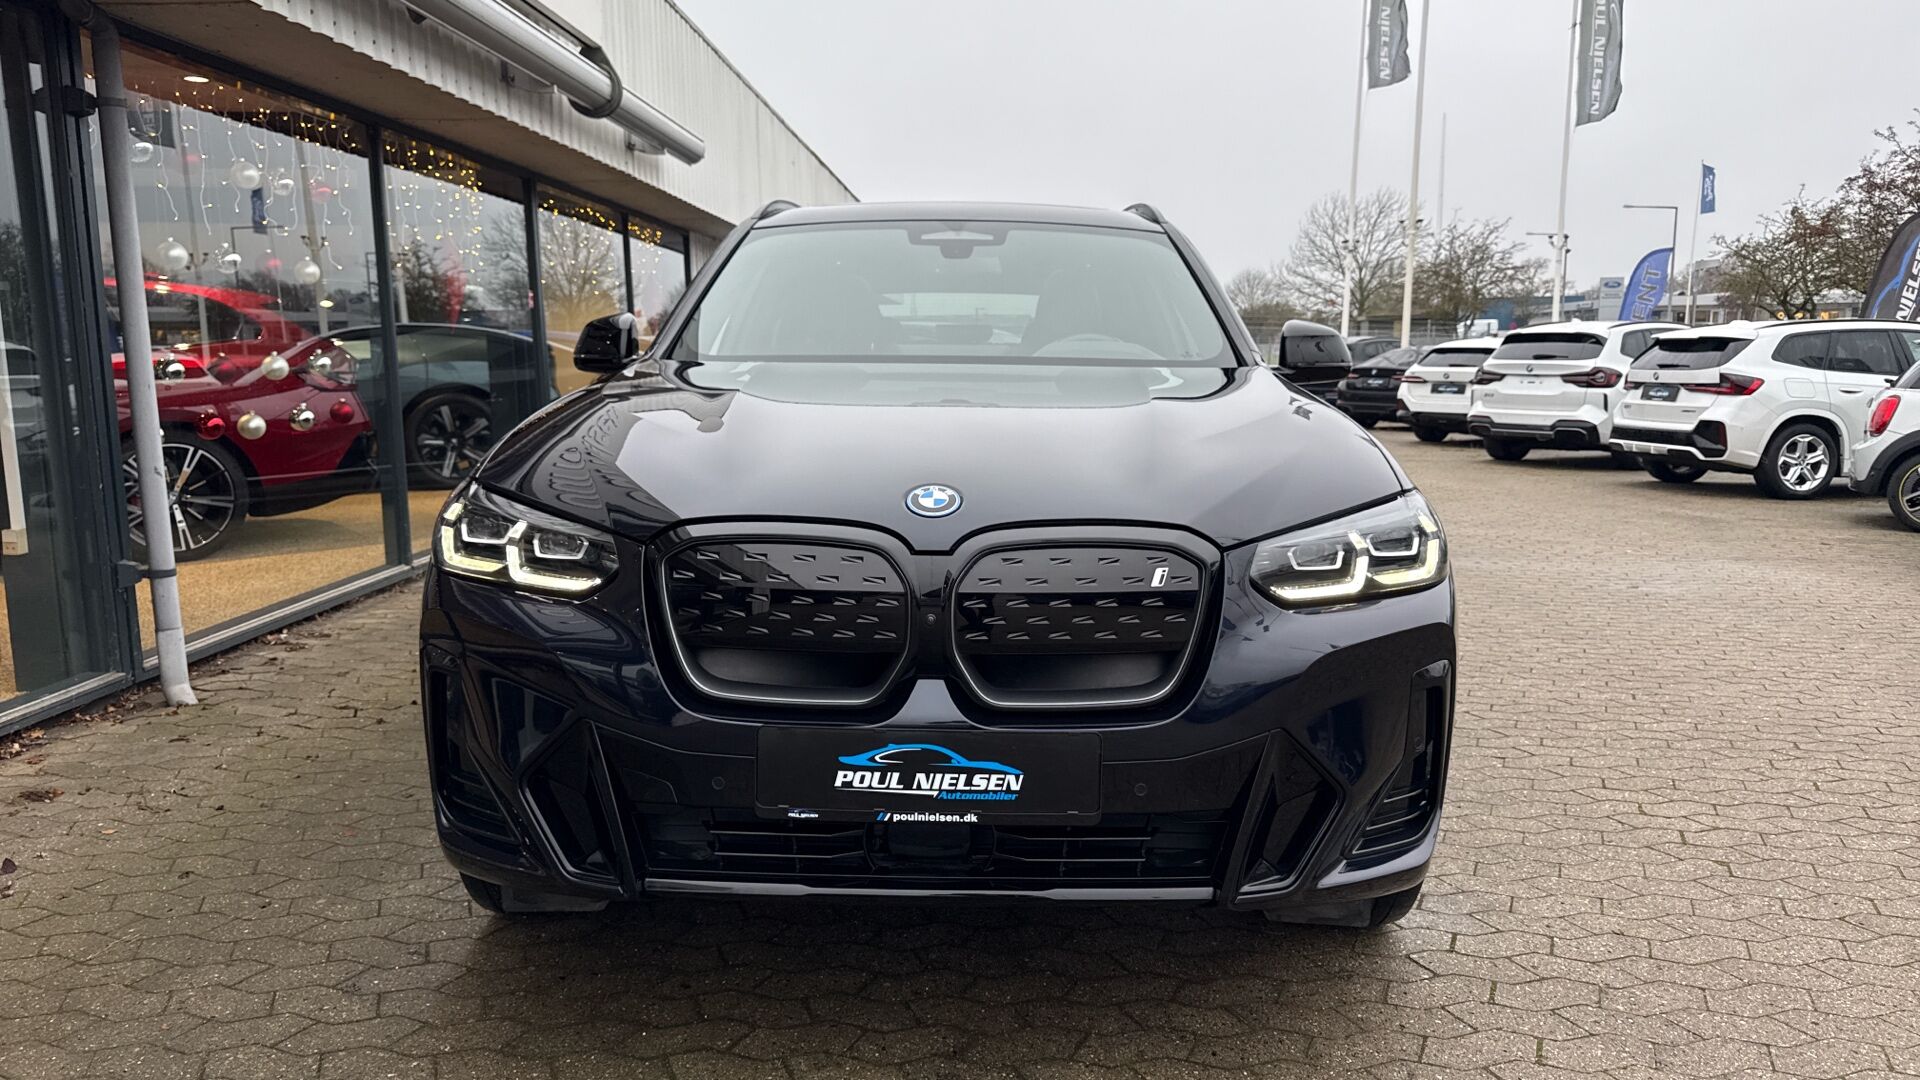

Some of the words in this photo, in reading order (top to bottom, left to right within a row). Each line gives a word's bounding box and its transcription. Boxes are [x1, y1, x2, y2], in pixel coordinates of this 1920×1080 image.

[1380, 6, 1391, 80] NIELSEN
[1590, 36, 1606, 115] NIELSEN
[834, 770, 904, 790] POUL
[912, 773, 1024, 791] NIELSEN
[938, 790, 1019, 801] Automobiler
[892, 812, 978, 823] poulnielsen.dk
